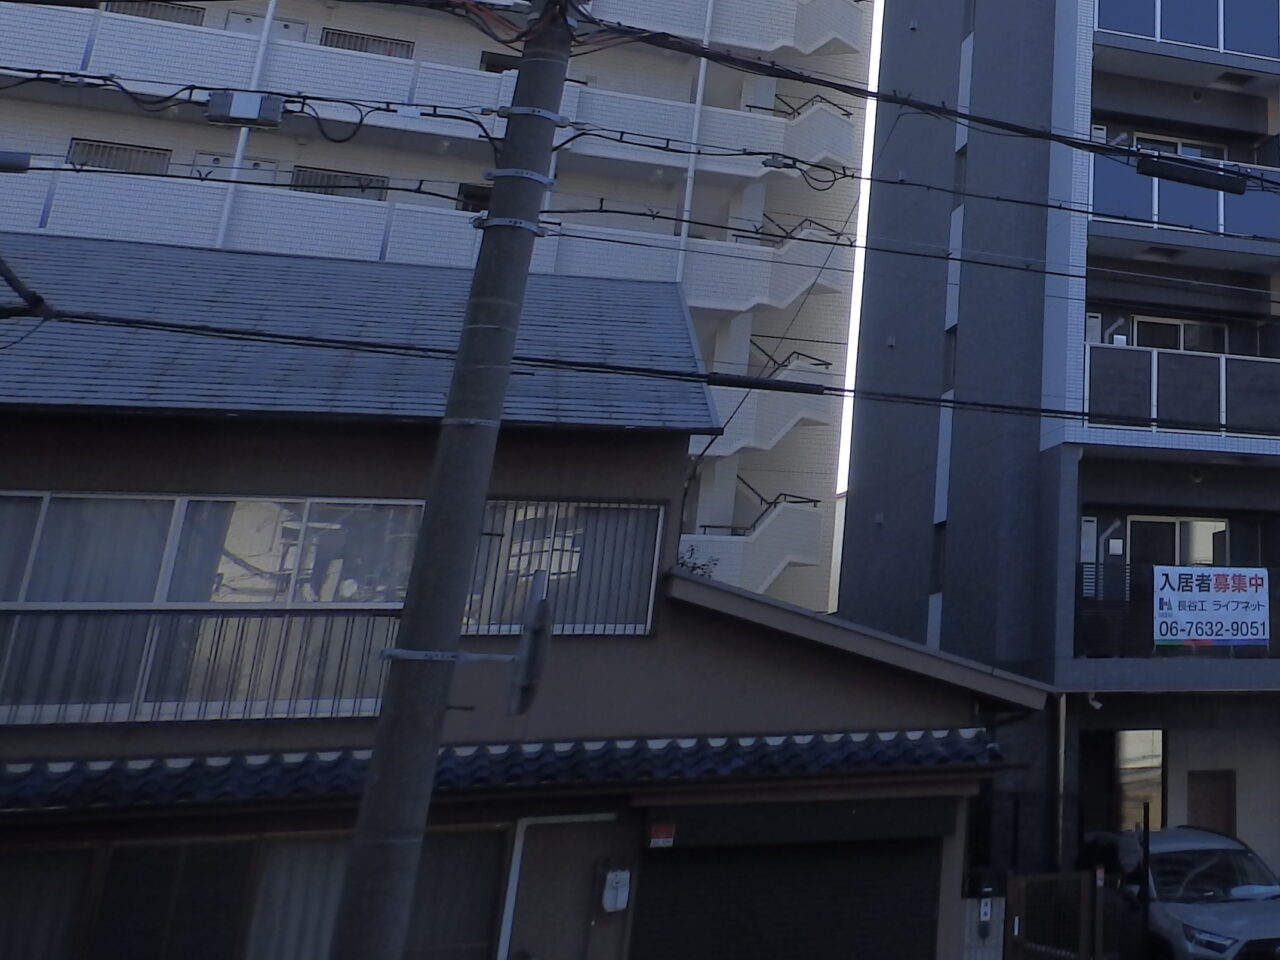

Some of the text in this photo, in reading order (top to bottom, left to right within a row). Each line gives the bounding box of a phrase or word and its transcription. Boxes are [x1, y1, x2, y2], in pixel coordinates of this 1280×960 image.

[1160, 572, 1264, 593] 入居者募集中
[1212, 600, 1265, 612] ライフネット
[1159, 621, 1266, 637] 06-7632-9051
